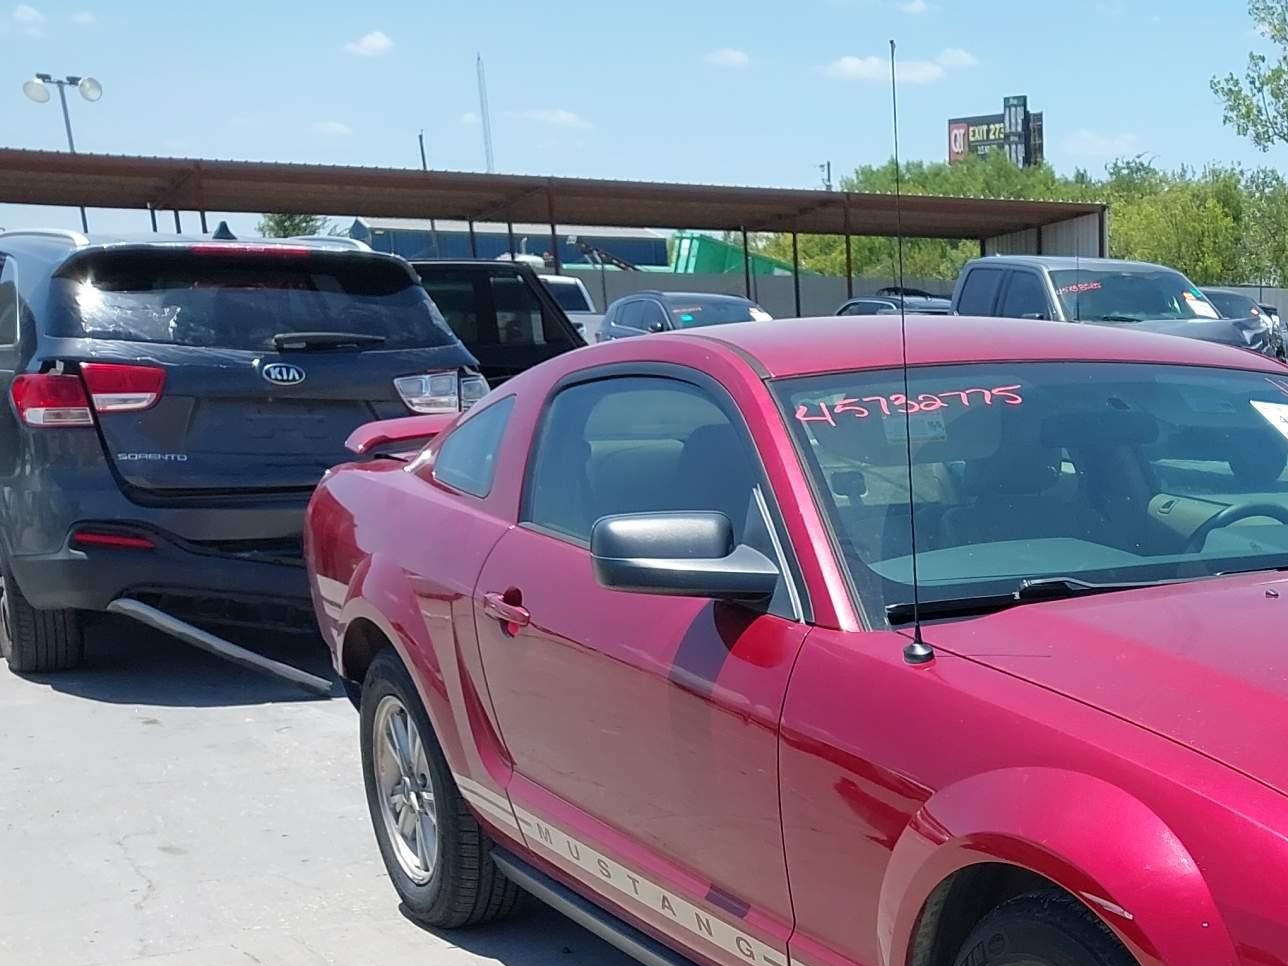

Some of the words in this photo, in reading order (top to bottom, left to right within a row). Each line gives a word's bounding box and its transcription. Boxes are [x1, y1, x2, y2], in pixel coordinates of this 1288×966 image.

[969, 125, 988, 141] EXIT
[269, 367, 300, 380] KIA
[795, 384, 1022, 427] 45732775
[117, 453, 188, 461] SORENTO
[536, 821, 755, 961] MUSTANG
